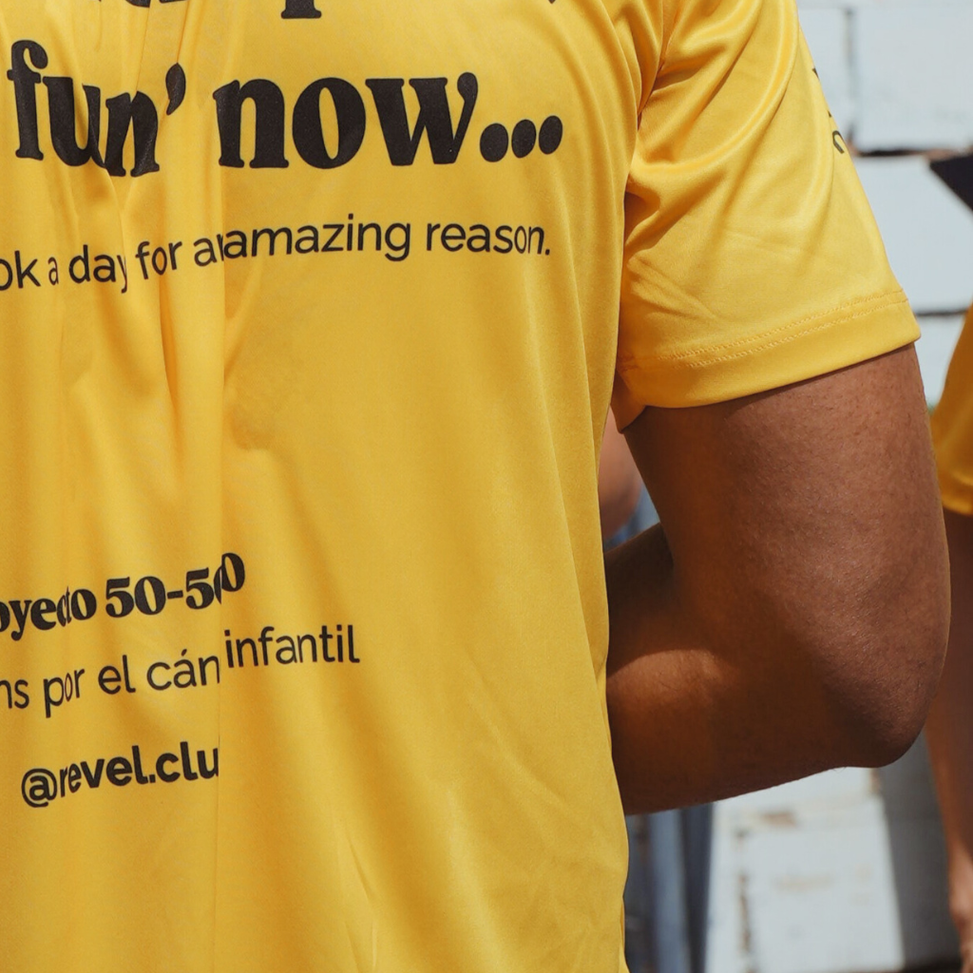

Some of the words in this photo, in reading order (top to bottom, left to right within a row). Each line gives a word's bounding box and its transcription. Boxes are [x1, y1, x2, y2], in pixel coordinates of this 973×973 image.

[7, 40, 187, 178] fun'
[213, 72, 564, 170] now...
[48, 256, 59, 286] a
[68, 244, 127, 294] day
[135, 240, 183, 280] for
[223, 213, 411, 262] amazing
[426, 223, 551, 256] reason.
[43, 670, 85, 719] por
[98, 654, 137, 695] el
[224, 624, 361, 668] infantil
